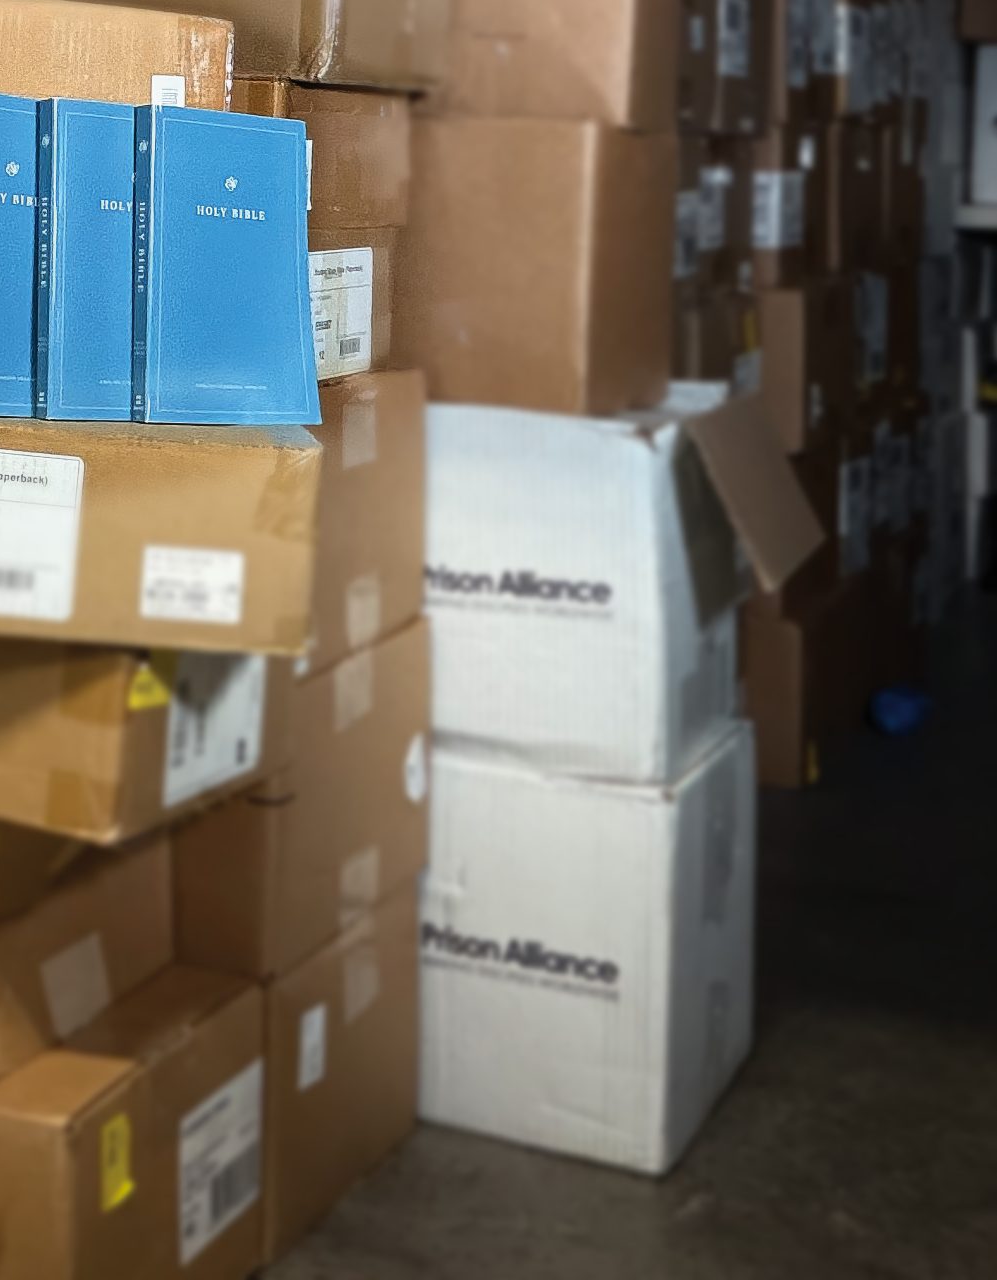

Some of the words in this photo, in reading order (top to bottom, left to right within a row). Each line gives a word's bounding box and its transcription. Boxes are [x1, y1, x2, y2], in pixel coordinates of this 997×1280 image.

[100, 199, 133, 212] HOLY
[138, 202, 146, 240] HOLY
[196, 205, 227, 218] HOLY
[231, 209, 266, 221] BIBLE
[498, 569, 612, 605] Alliance
[504, 937, 619, 984] Alliance
